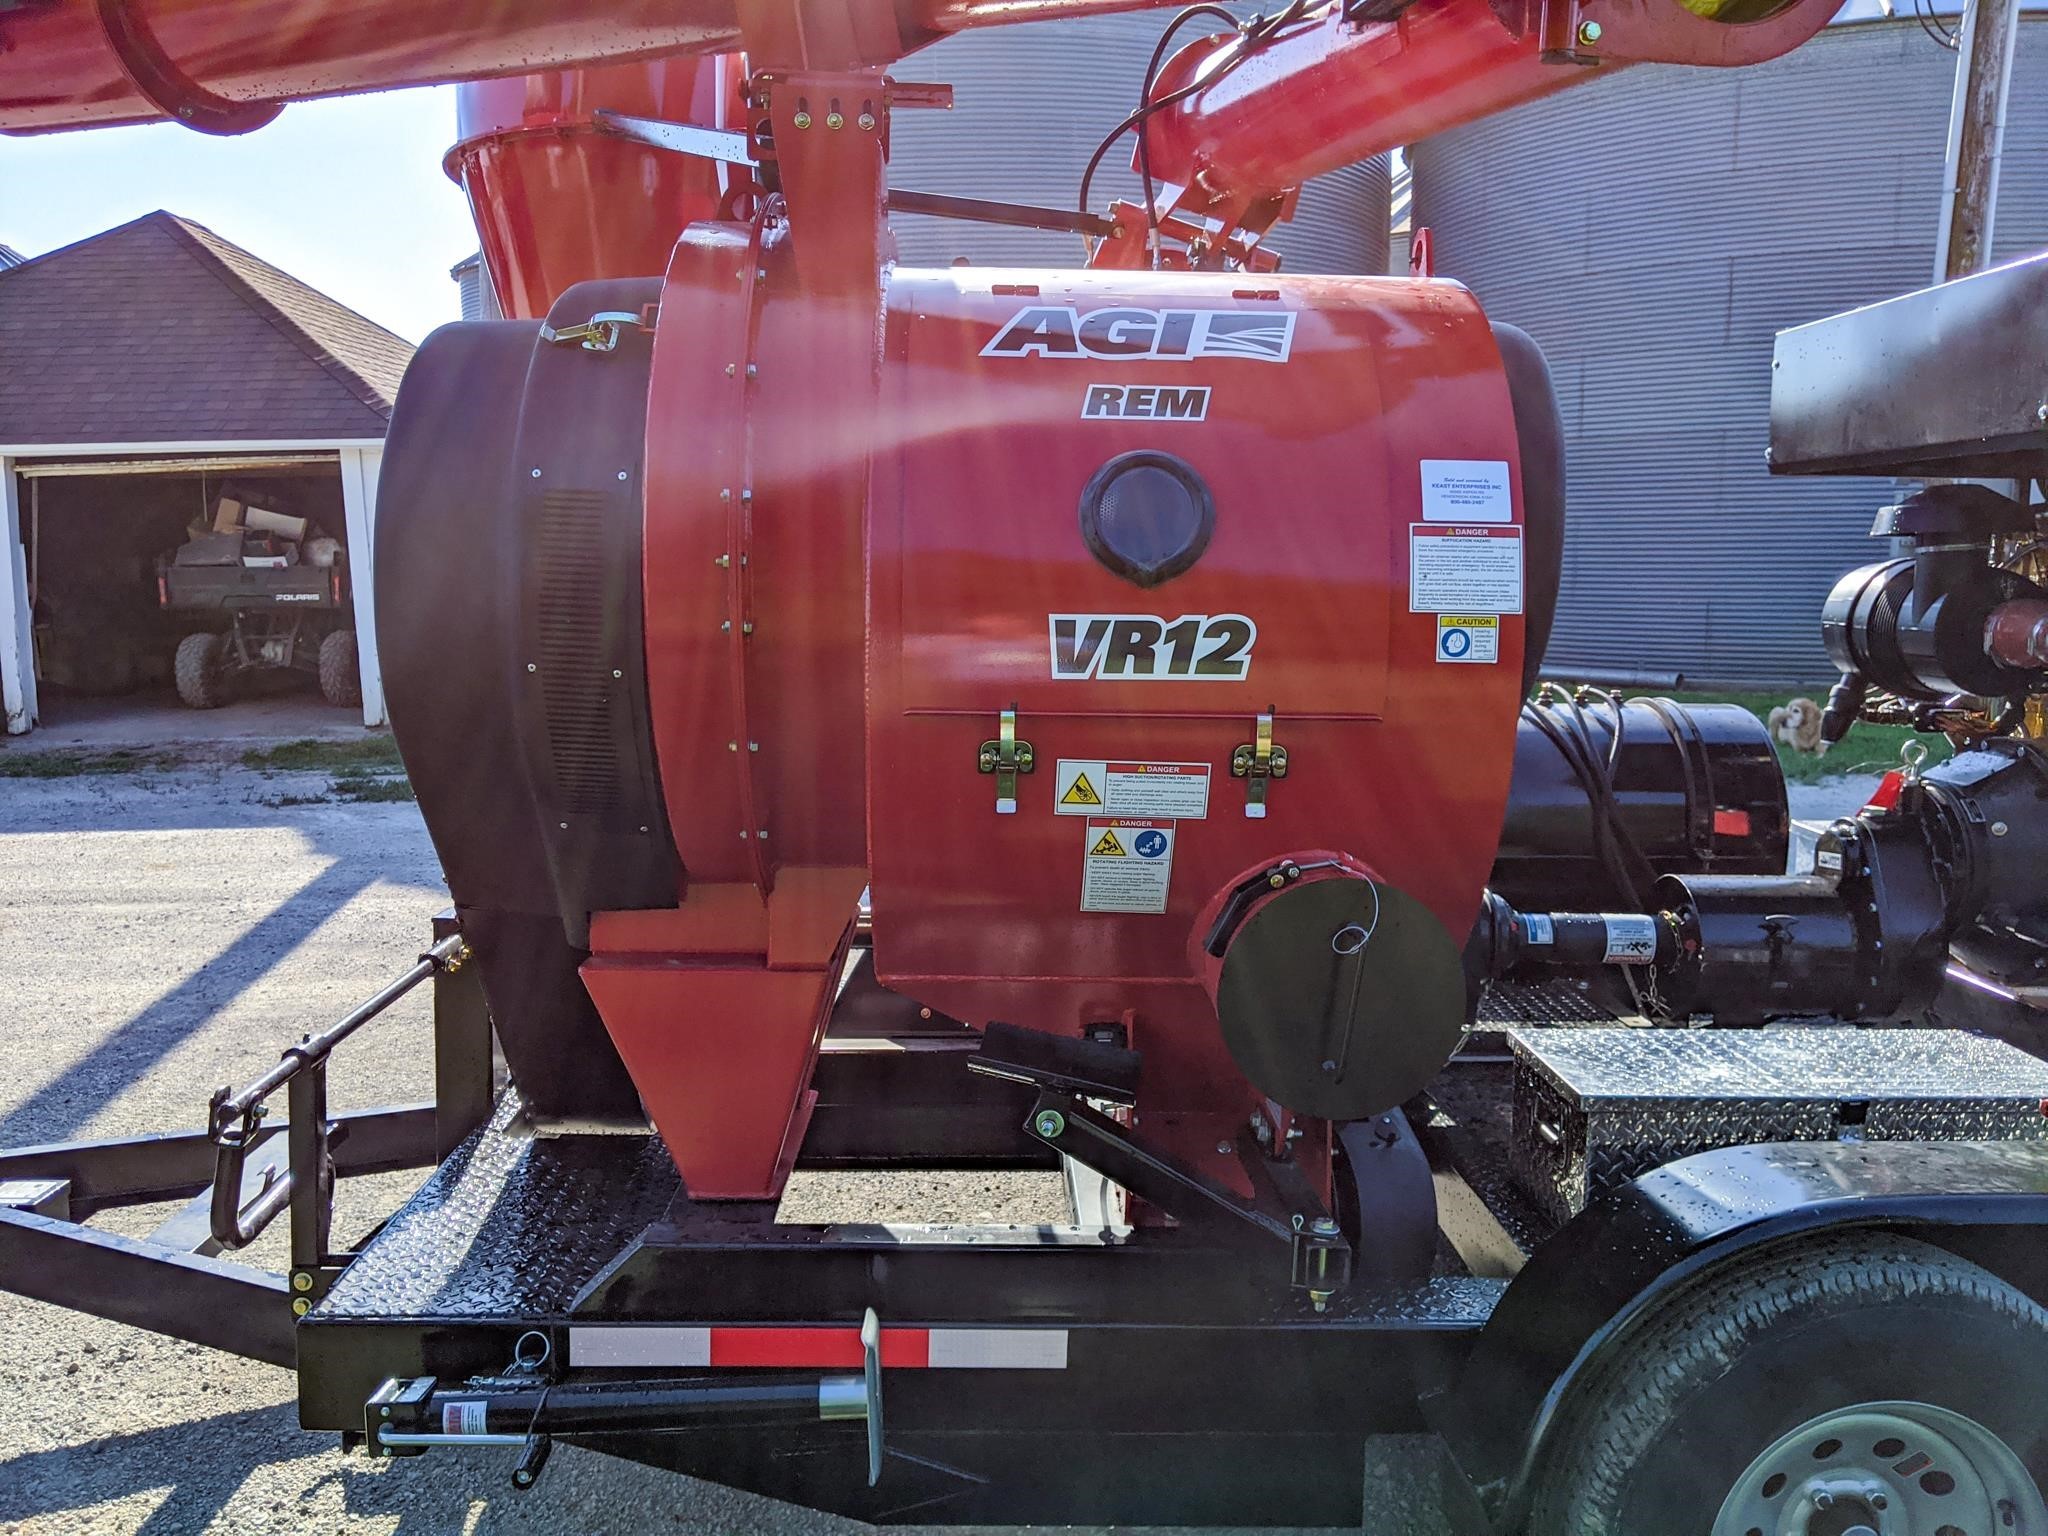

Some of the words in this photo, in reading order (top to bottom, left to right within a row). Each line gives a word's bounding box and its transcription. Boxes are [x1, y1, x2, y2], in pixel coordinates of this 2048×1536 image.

[979, 306, 1198, 360] AGI
[1081, 384, 1212, 421] REM
[1455, 528, 1489, 536] DANGER
[275, 593, 320, 601] POLARIS
[1456, 618, 1492, 626] CAUTION
[1048, 614, 1257, 681] VR12
[1146, 765, 1180, 774] DANGER
[1120, 820, 1152, 828] DANGER
